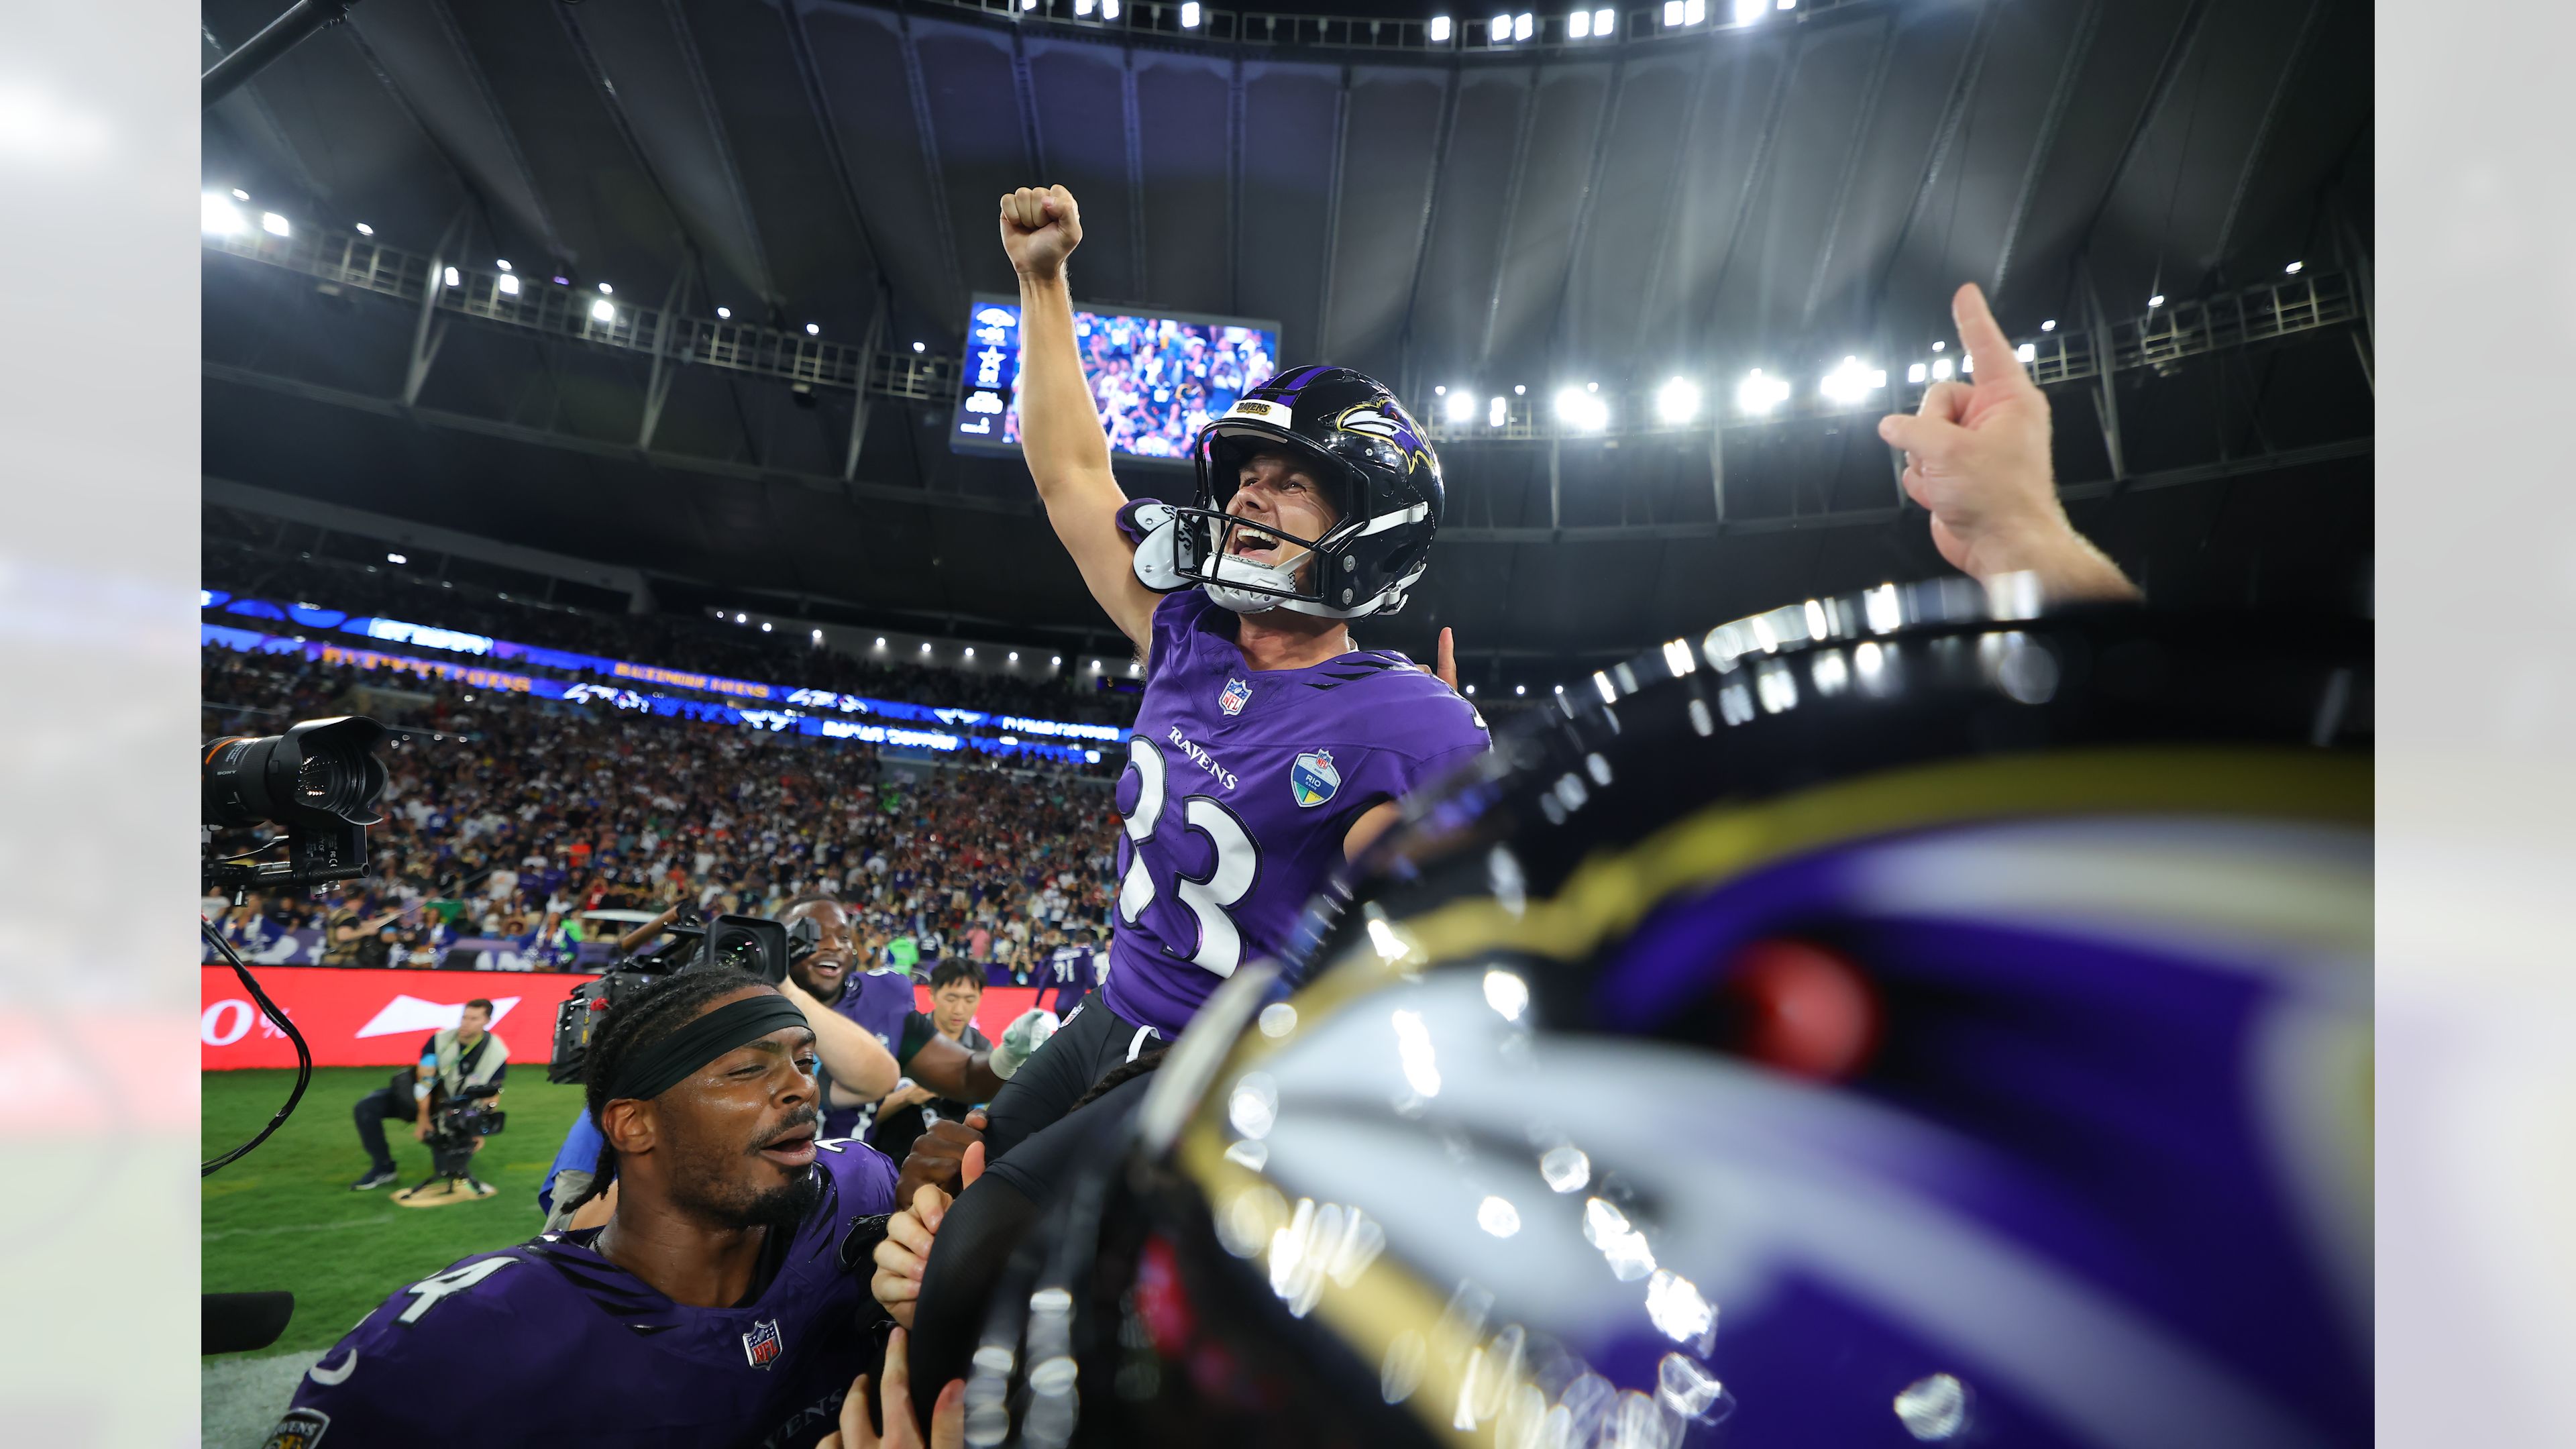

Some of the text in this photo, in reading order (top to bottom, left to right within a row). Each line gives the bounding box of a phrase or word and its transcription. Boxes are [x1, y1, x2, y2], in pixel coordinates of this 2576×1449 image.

[1236, 402, 1271, 415] RAVENS
[1222, 694, 1240, 710] NFL
[1167, 726, 1238, 790] RAVENS
[1317, 757, 1328, 769] NFL
[1305, 774, 1322, 788] RIO
[1305, 782, 1318, 791] GAME
[1053, 960, 1075, 983] 91
[752, 1338, 779, 1364] NFL
